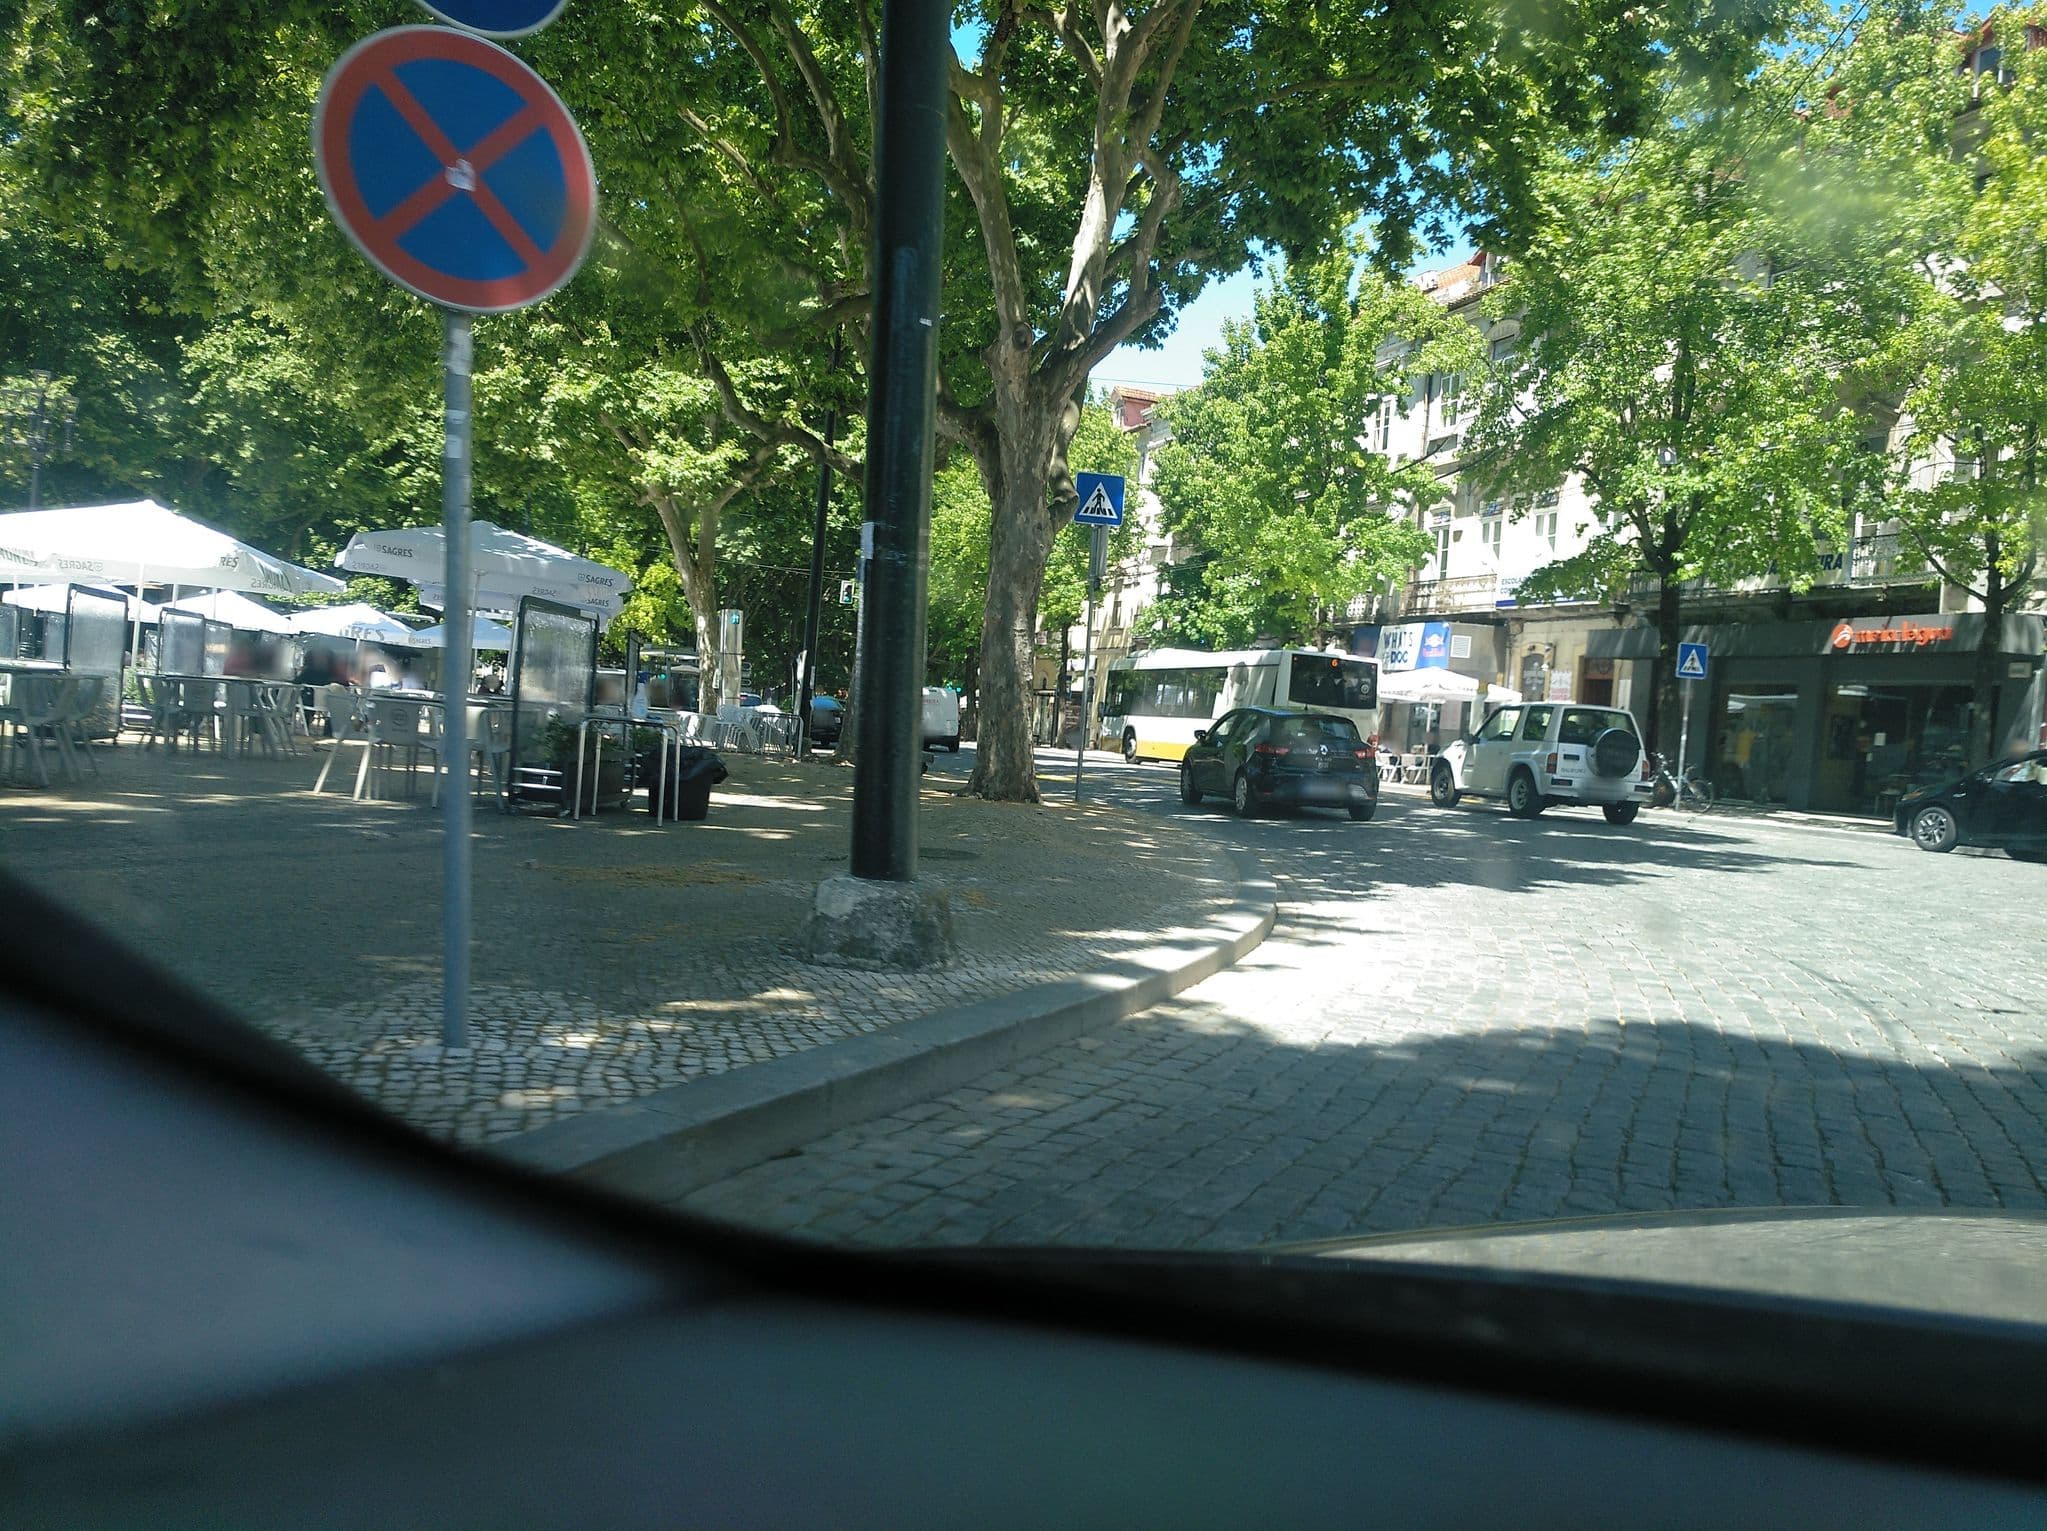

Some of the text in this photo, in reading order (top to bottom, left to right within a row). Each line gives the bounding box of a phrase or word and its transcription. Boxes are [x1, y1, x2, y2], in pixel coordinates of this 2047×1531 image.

[381, 545, 414, 558] SAGRES
[585, 574, 614, 587] SAGRES
[1390, 649, 1409, 664] DOC
